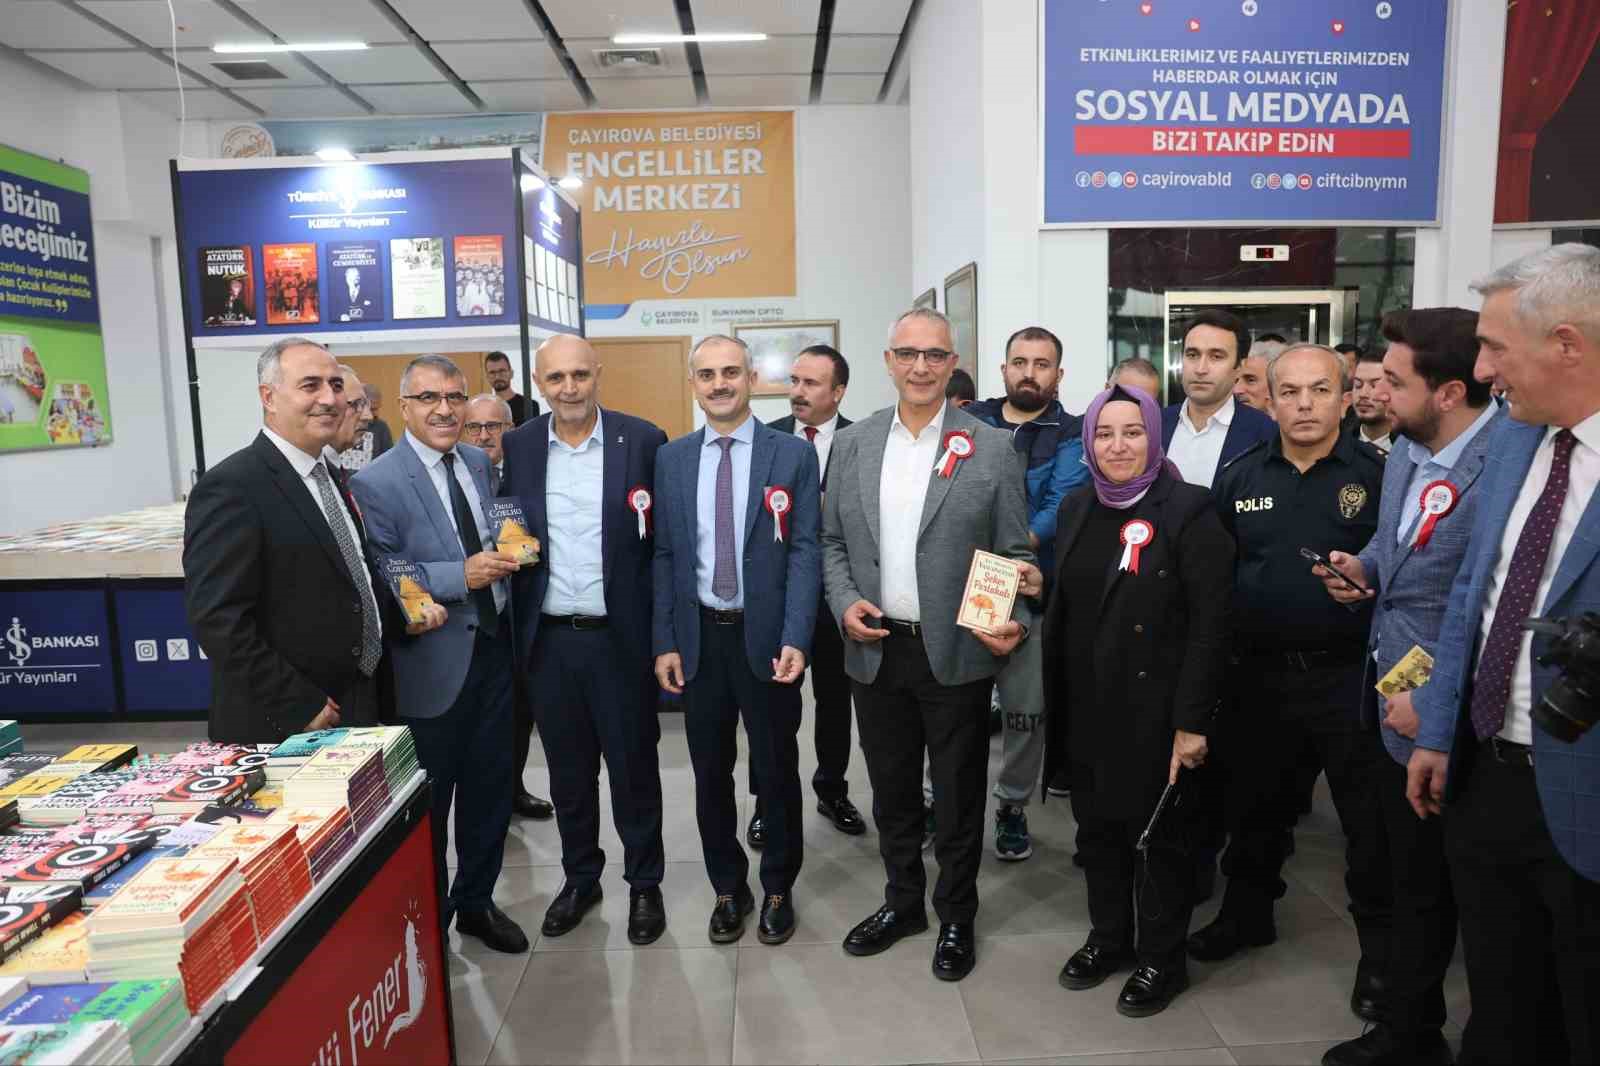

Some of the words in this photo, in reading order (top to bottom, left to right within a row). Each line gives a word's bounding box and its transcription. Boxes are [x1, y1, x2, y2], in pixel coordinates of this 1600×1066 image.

[1219, 50, 1238, 63] VE
[1152, 69, 1239, 84] HABERDAR
[1243, 71, 1301, 85] OLMAK
[1075, 89, 1217, 121] SOSYAL
[1227, 91, 1410, 124] MEDYADA
[568, 128, 655, 145] ÇAYIROVA
[660, 122, 762, 142] BELEDİYESİ
[566, 148, 766, 177] ENGELLİLER
[1142, 171, 1232, 189] cayirovabld
[1316, 173, 1408, 191] ciftcibnymn
[1, 181, 61, 224] Bizim
[593, 183, 742, 212] MERKEZİ
[0, 223, 89, 262] eceğimiz
[207, 264, 246, 276] NUTUK
[663, 247, 751, 294] Olsun
[32, 635, 99, 649] BANKASI
[15, 671, 77, 685] Yayınları
[348, 952, 402, 1066] Fener
